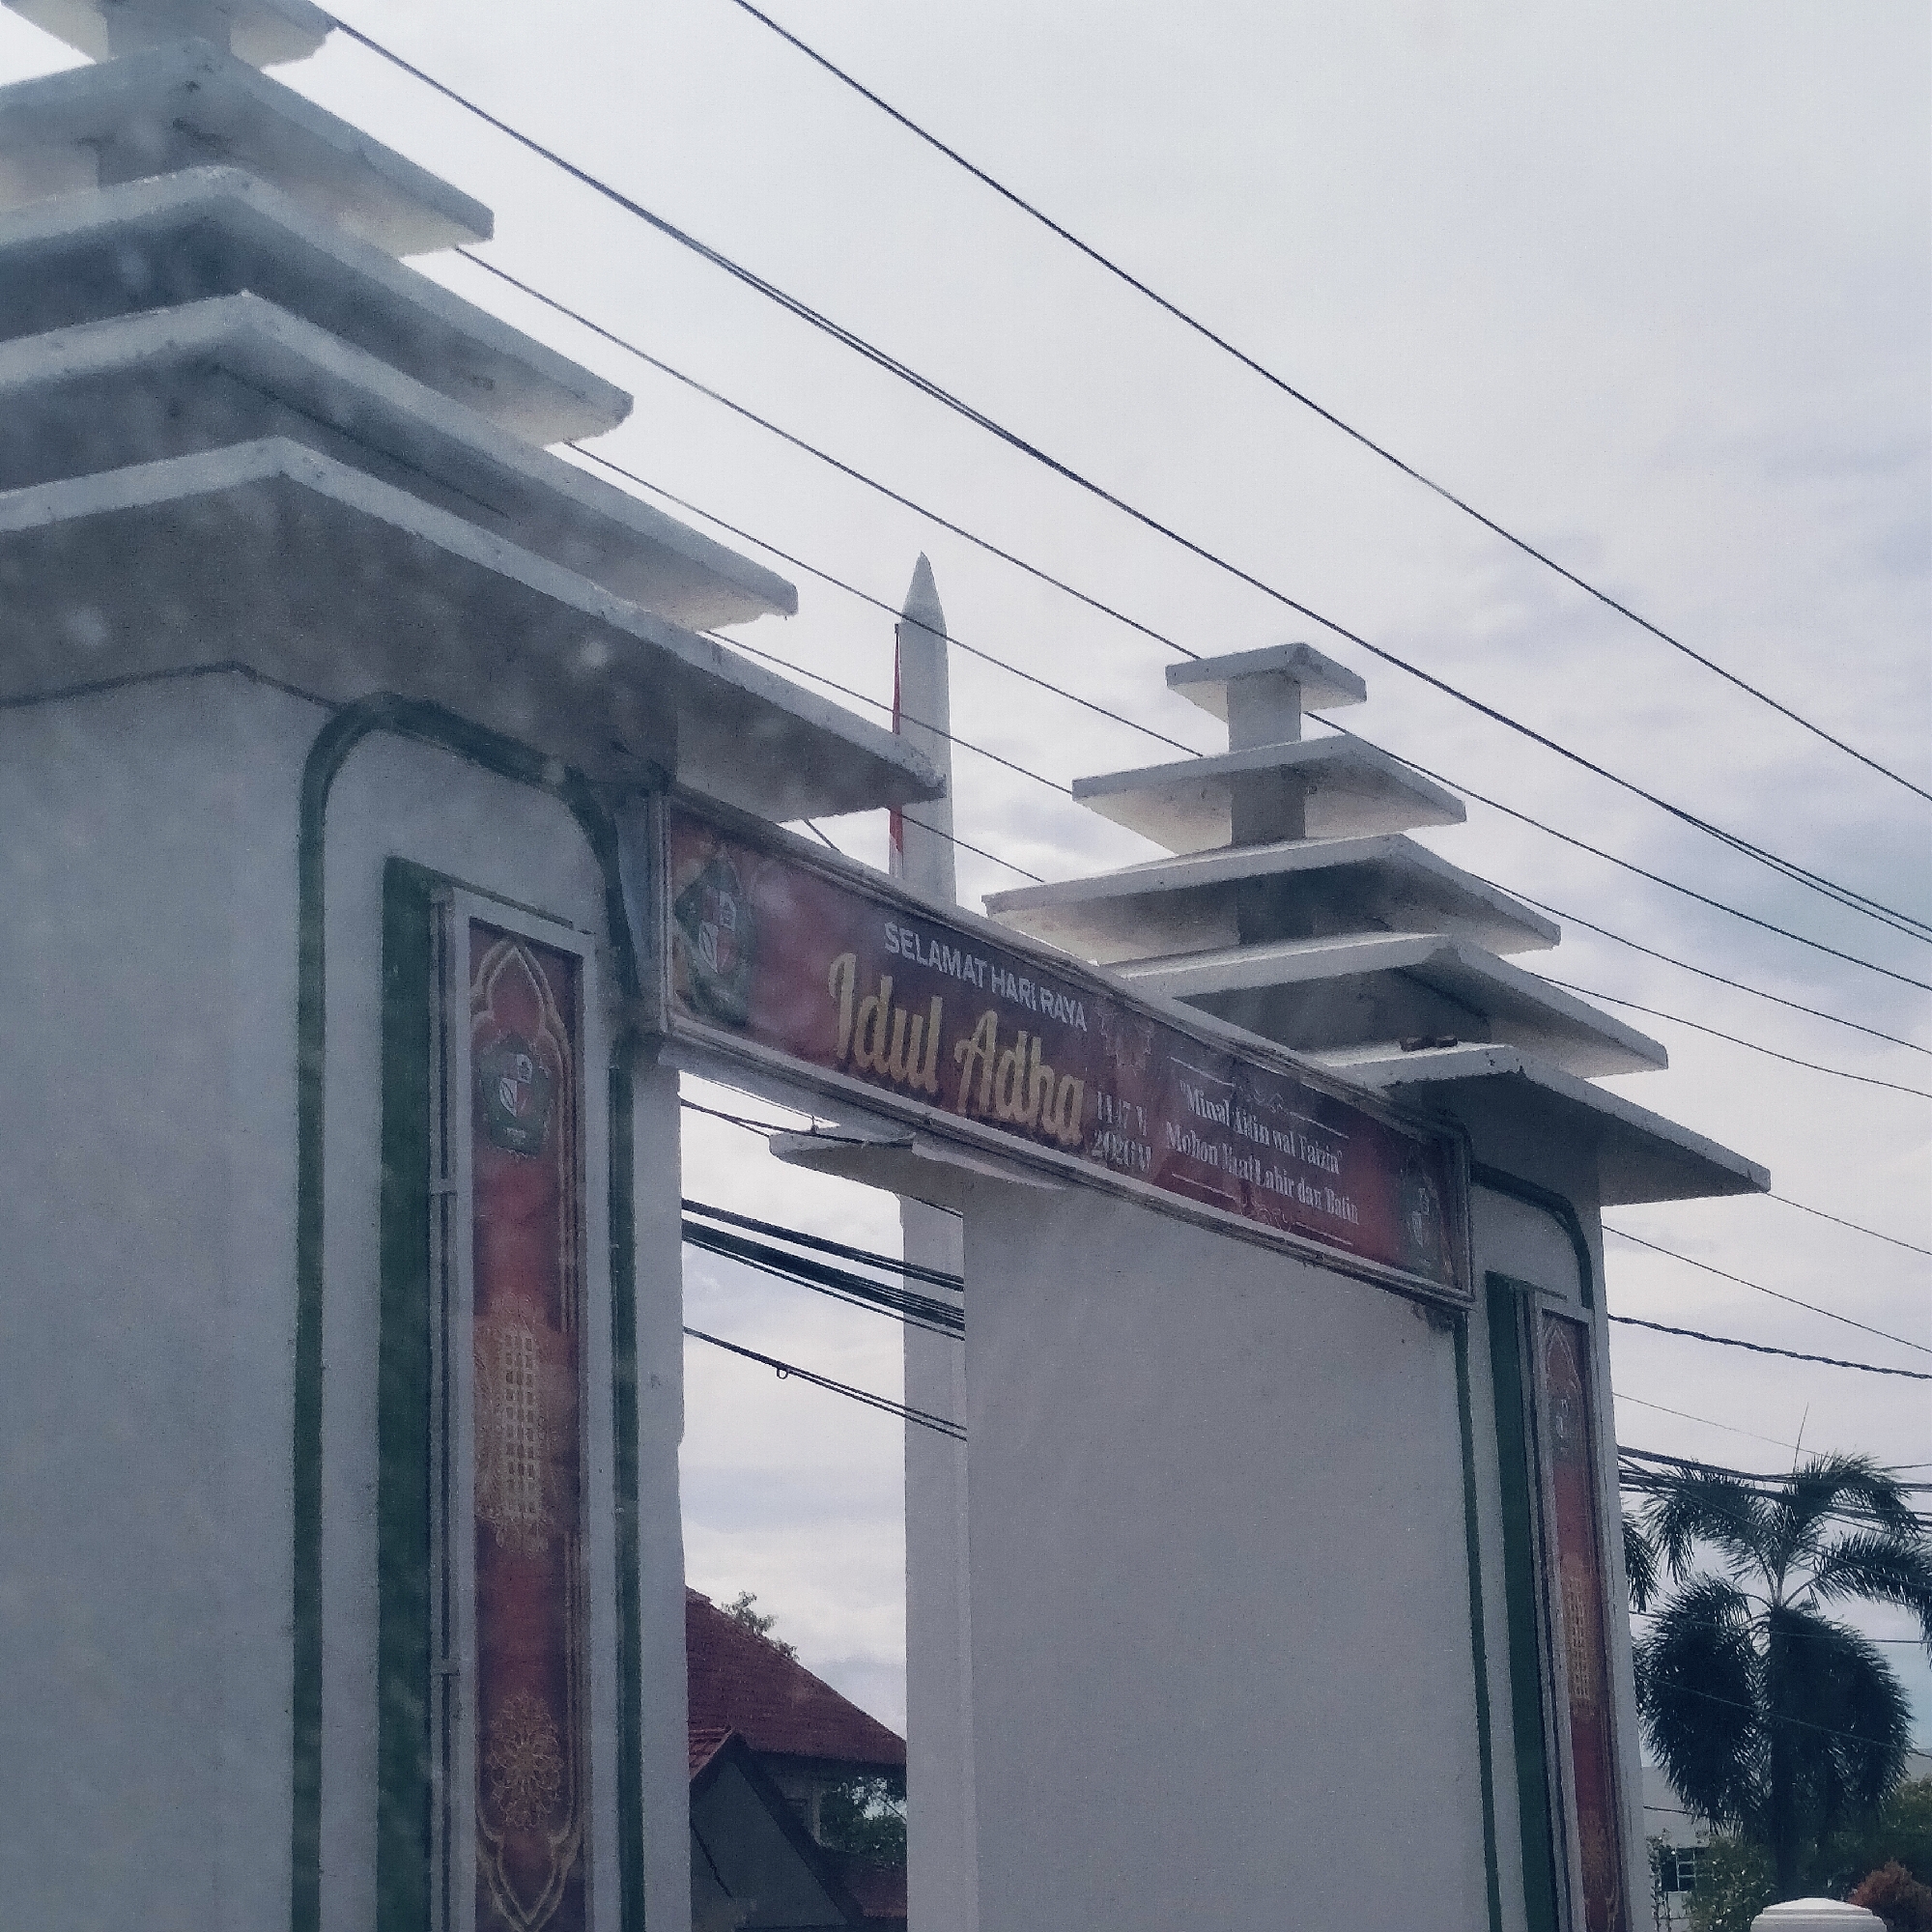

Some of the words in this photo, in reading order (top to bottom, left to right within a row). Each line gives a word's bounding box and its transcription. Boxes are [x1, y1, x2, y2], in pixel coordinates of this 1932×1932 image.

[884, 921, 987, 988] SELAMAT
[991, 966, 1037, 1011] HARI
[1039, 986, 1088, 1033] RAYA
[829, 952, 944, 1094] Idul
[953, 1009, 1084, 1146] Adha
[1166, 1121, 1218, 1166] Mohon
